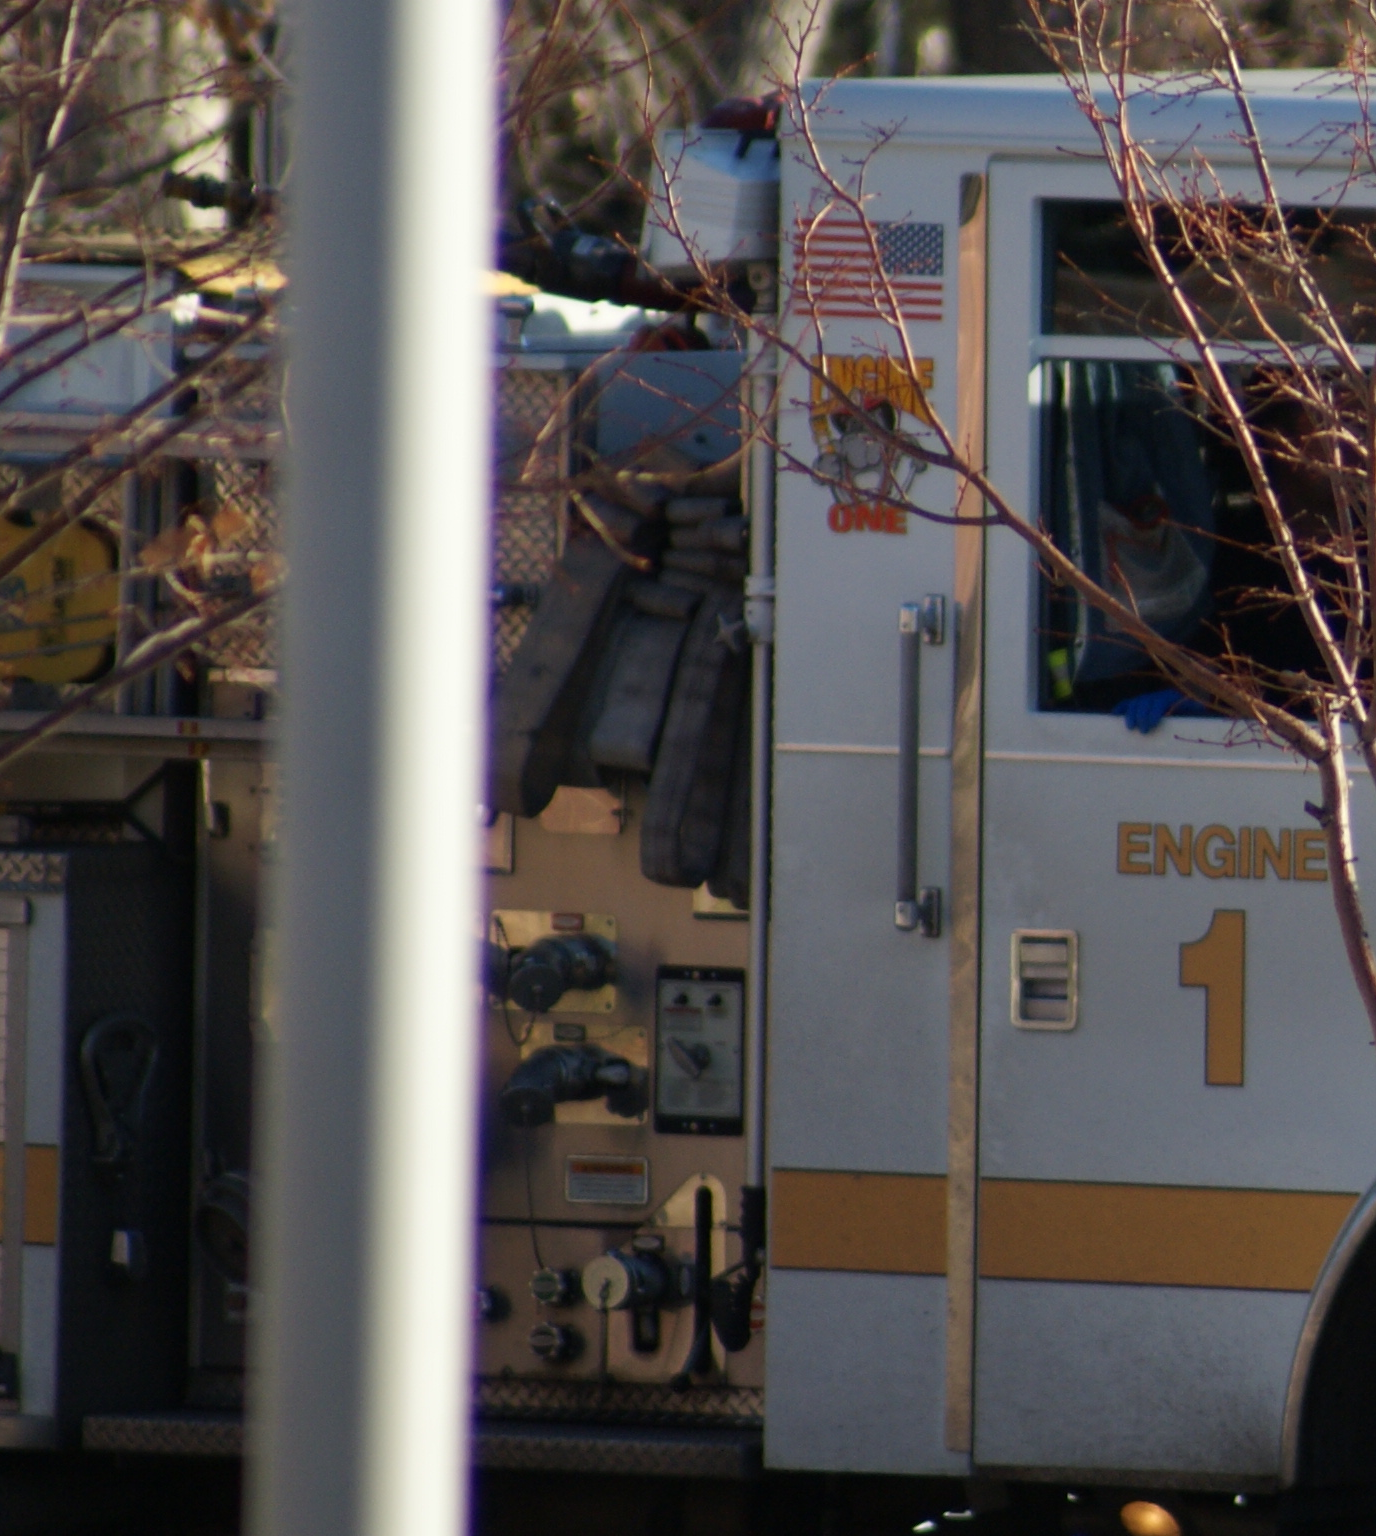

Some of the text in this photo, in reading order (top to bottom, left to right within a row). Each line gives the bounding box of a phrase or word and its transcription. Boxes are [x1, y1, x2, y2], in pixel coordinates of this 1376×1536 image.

[828, 502, 908, 535] ONE
[1117, 821, 1330, 882] ENGINE
[1179, 908, 1246, 1087] 1
